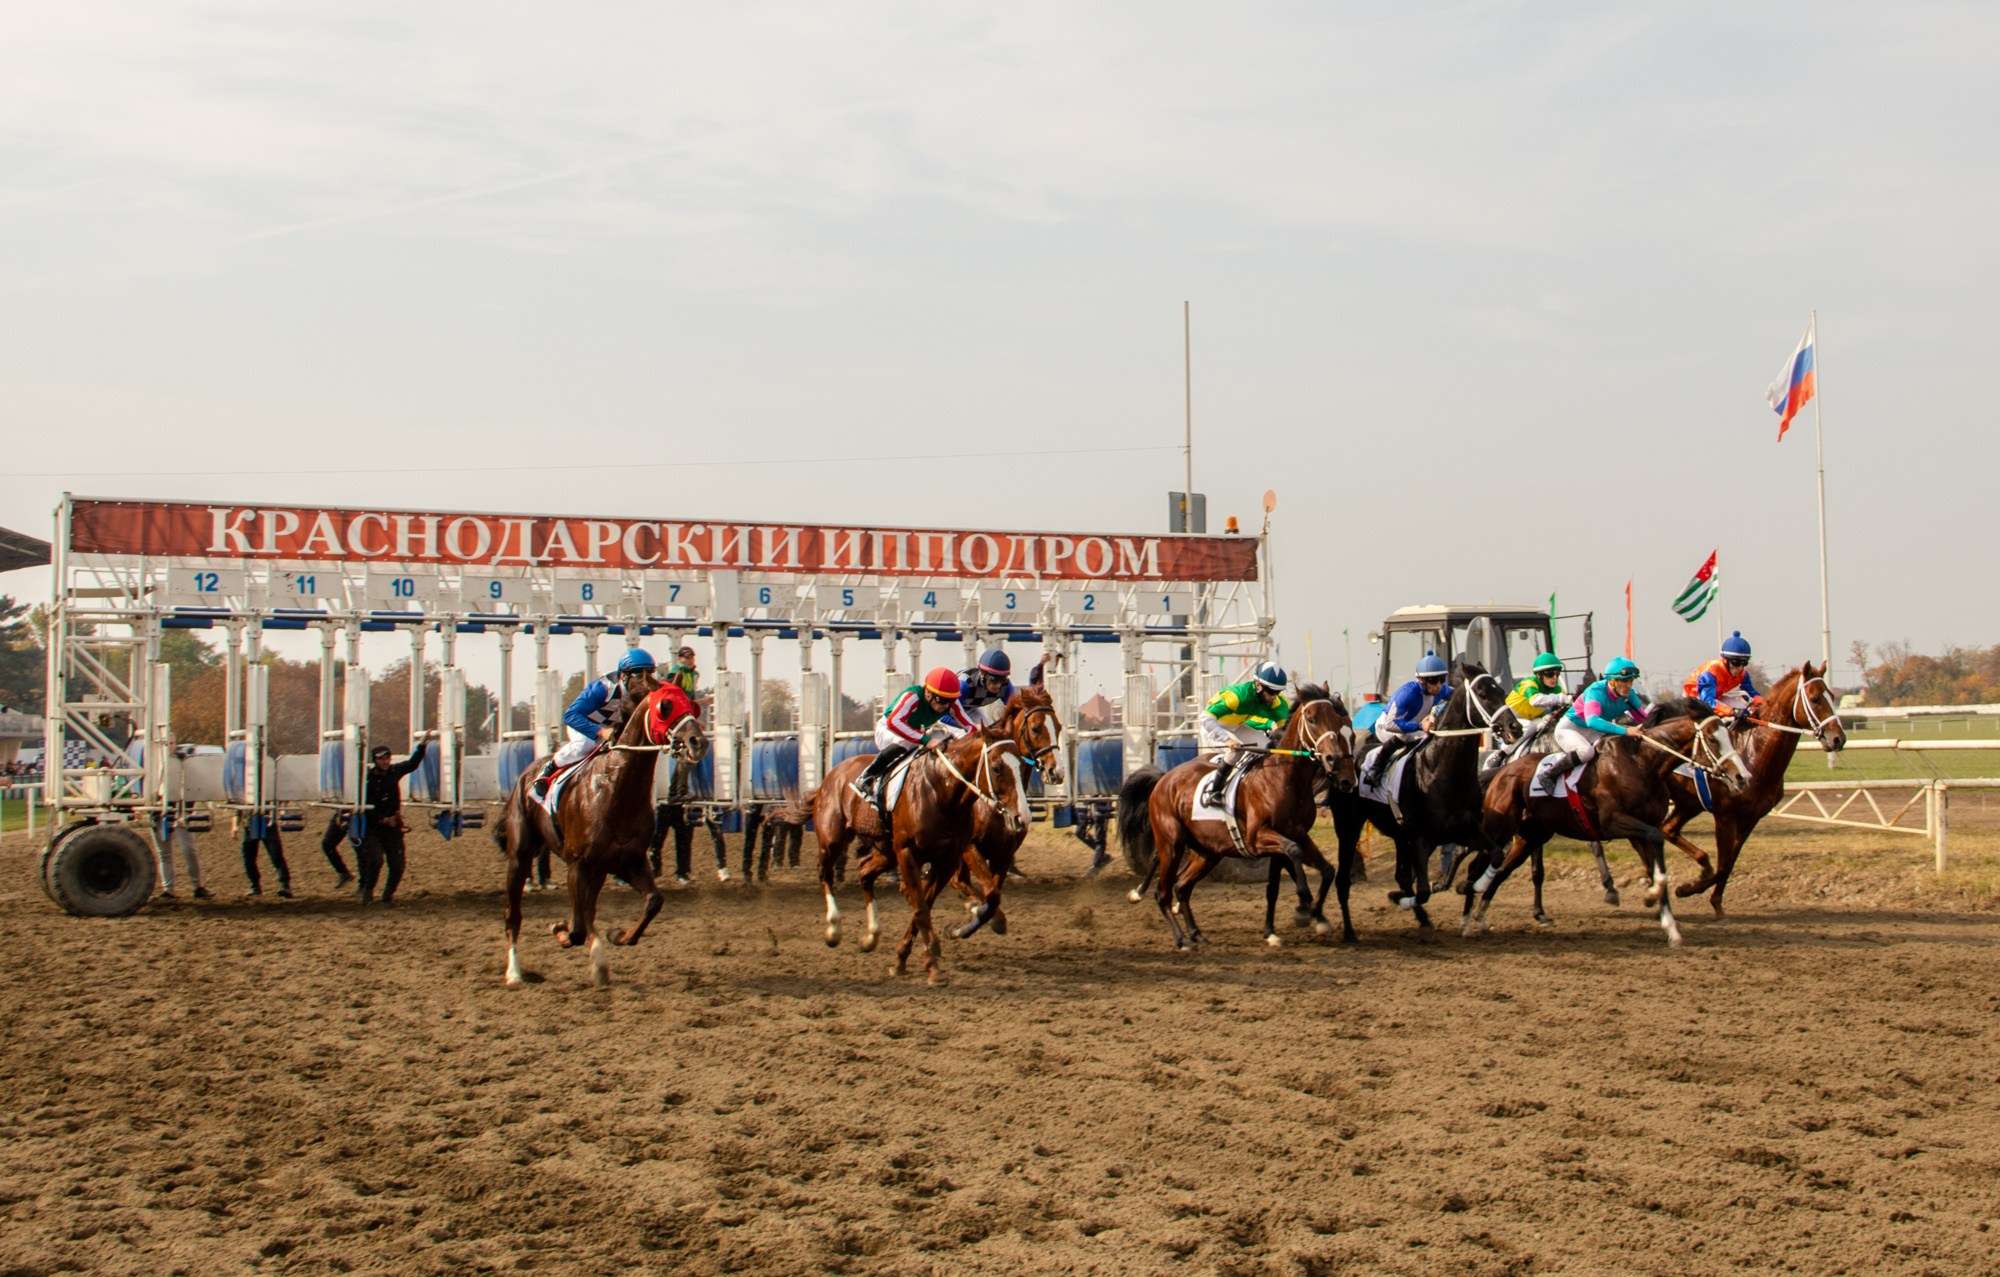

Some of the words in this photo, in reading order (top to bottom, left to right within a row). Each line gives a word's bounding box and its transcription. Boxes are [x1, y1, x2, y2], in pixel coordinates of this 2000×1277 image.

[819, 528, 1163, 580] ИППОДРОМ
[193, 572, 219, 592] 12
[296, 575, 315, 594] 11
[390, 577, 414, 597] 10
[489, 580, 502, 599] 9
[581, 583, 593, 601] 8
[669, 584, 680, 602] 7
[758, 587, 771, 606] 6
[841, 588, 854, 607] 5
[923, 591, 937, 608] 4
[1005, 592, 1016, 610] 3
[1083, 594, 1095, 611] 2
[1162, 595, 1171, 612] 1
